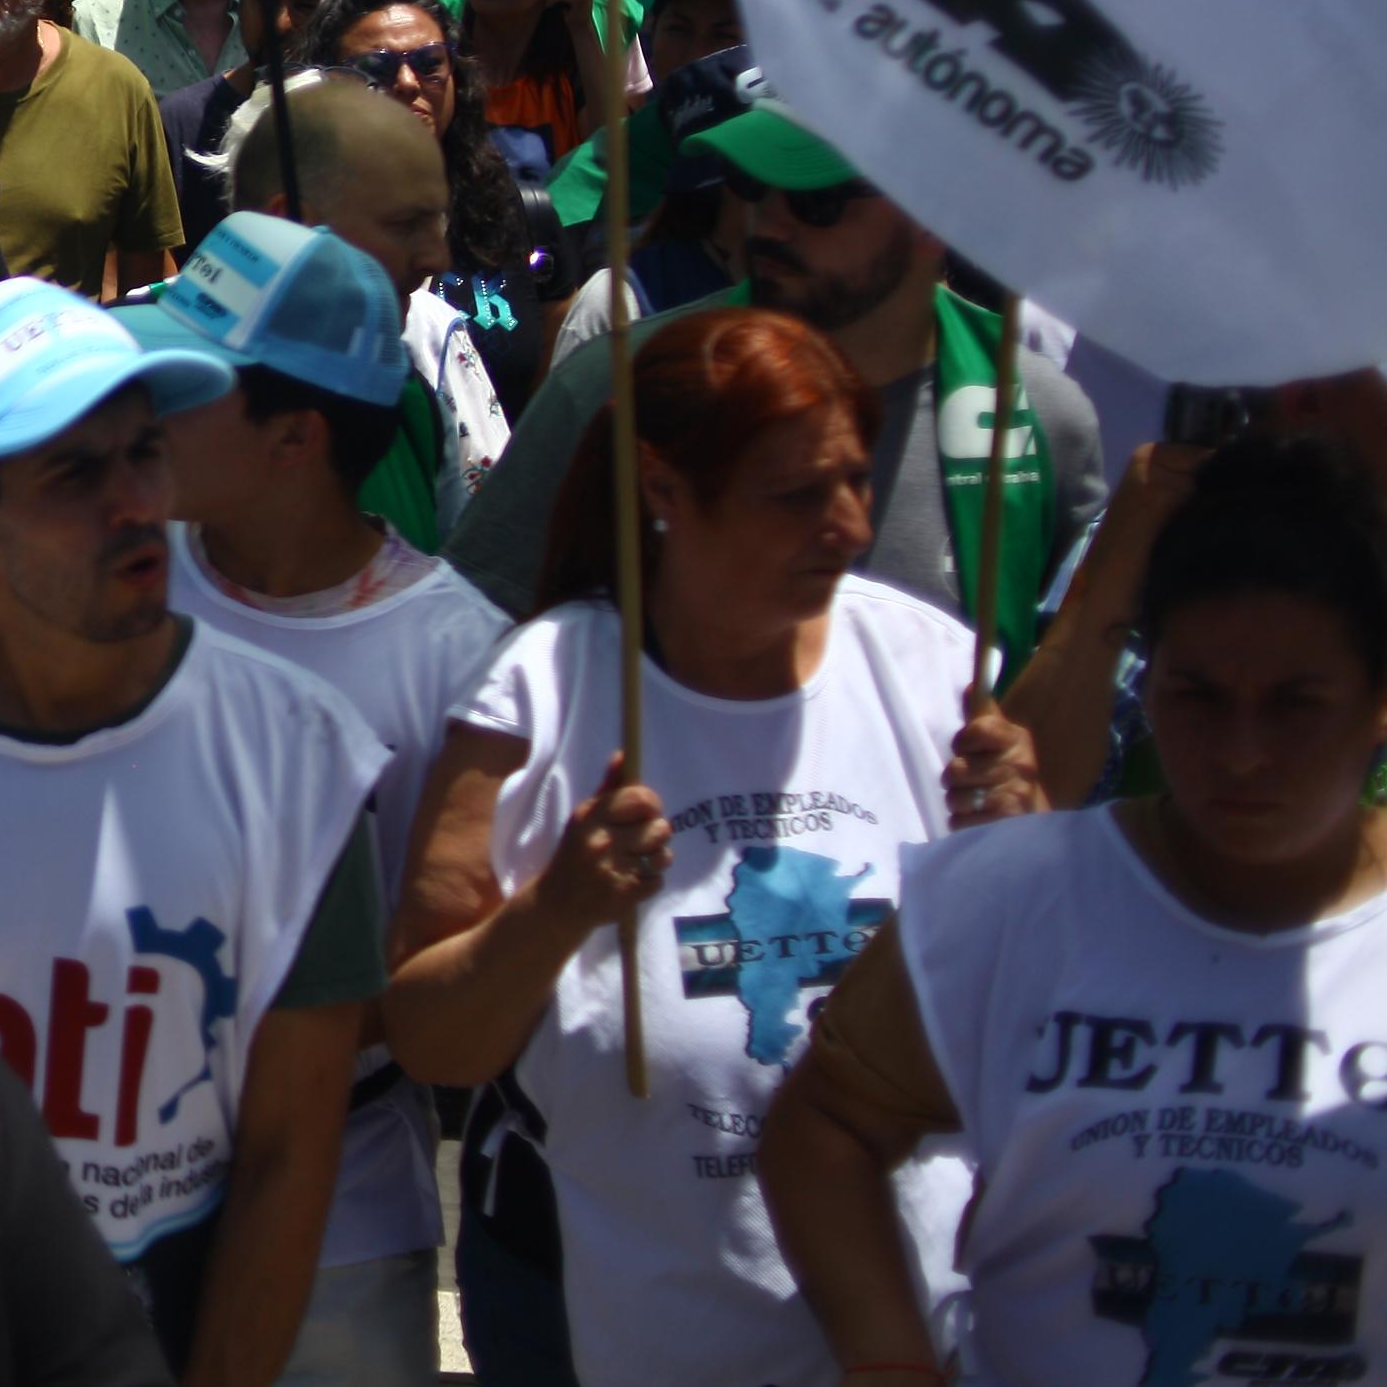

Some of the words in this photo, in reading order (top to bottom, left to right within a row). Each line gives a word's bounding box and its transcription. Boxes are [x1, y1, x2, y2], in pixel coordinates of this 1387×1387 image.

[853, 1, 1097, 181] autónoma
[718, 792, 748, 816] DE
[750, 790, 880, 826] EMPLEADOS
[702, 822, 720, 844] Y
[727, 811, 834, 842] TECNICOS
[1070, 1110, 1147, 1154] UNION
[1156, 1106, 1198, 1133] DE
[1205, 1108, 1379, 1170] EMPLEADOS
[1131, 1134, 1151, 1160] Y
[1158, 1132, 1306, 1170] TECNICOS
